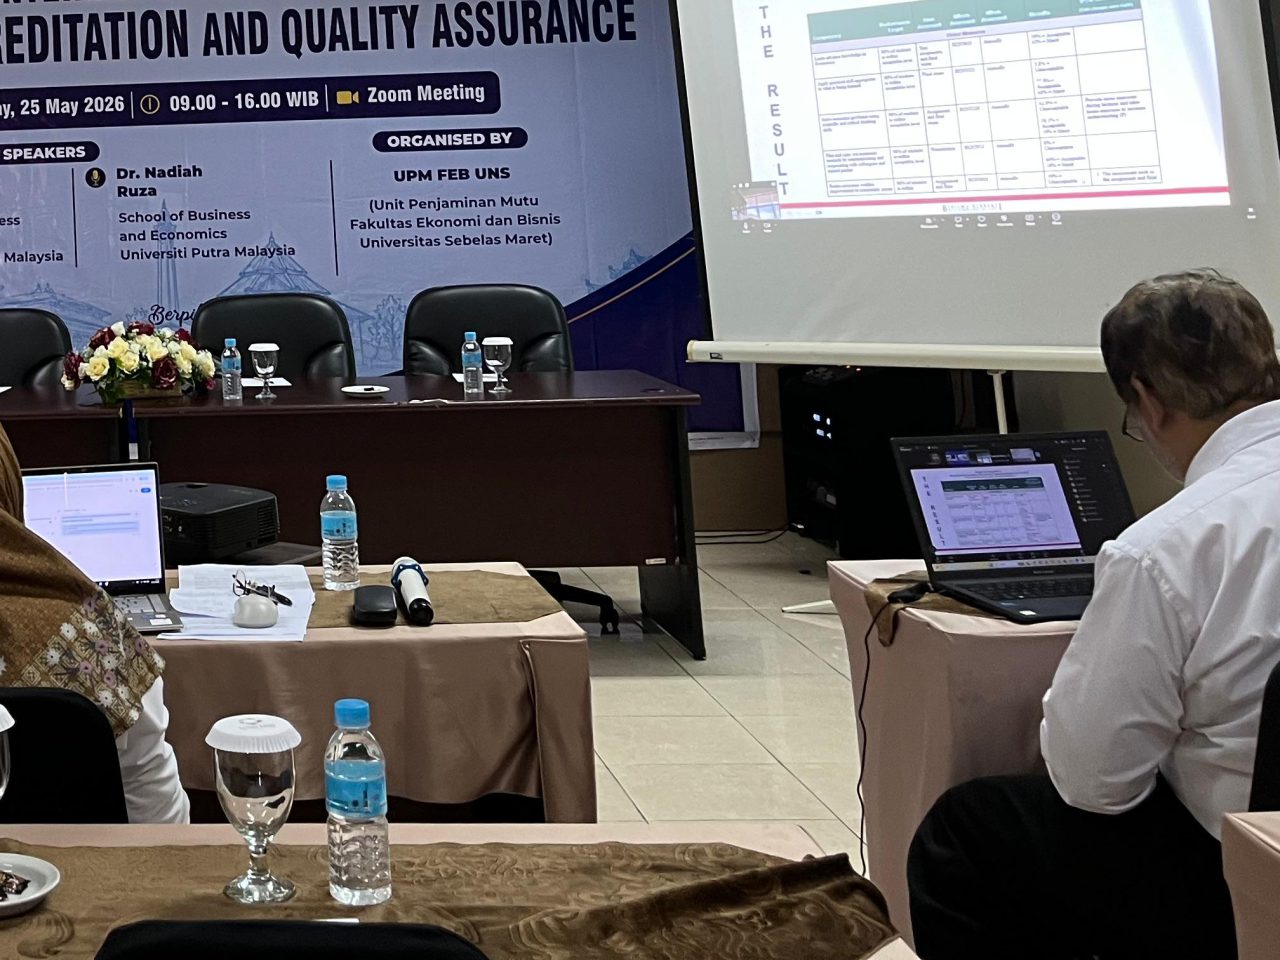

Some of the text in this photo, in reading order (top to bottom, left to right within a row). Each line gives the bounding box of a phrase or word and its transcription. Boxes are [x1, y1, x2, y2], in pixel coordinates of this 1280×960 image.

[203, 10, 268, 57] AND
[281, 4, 419, 59] QUALITY
[169, 94, 216, 112] 09.00
[235, 92, 281, 109] 16.00
[285, 91, 319, 108] WIB
[367, 83, 485, 103] Zoom Meeting
[758, 5, 789, 196] THE RESULT
[20, 98, 40, 115] 25
[45, 98, 79, 118] May
[84, 96, 125, 114] 2026
[387, 132, 513, 148] ORGANISED BY
[3, 145, 86, 161] SPEAKERS
[116, 165, 203, 180] Dr. Nadiah
[393, 167, 511, 182] UPM FEB UNS
[117, 185, 157, 198] Ruza
[369, 196, 539, 213] (Unit Penjaminan Mutu
[118, 208, 251, 223] School of Business
[350, 213, 561, 231] Fakultas Ekonomi dan Bisnis
[119, 227, 227, 242] and Economics
[360, 233, 553, 249] Universitas Sebelas Maret)
[4, 249, 64, 267] Malaysia
[120, 244, 295, 261] Universiti Putra Malaysia
